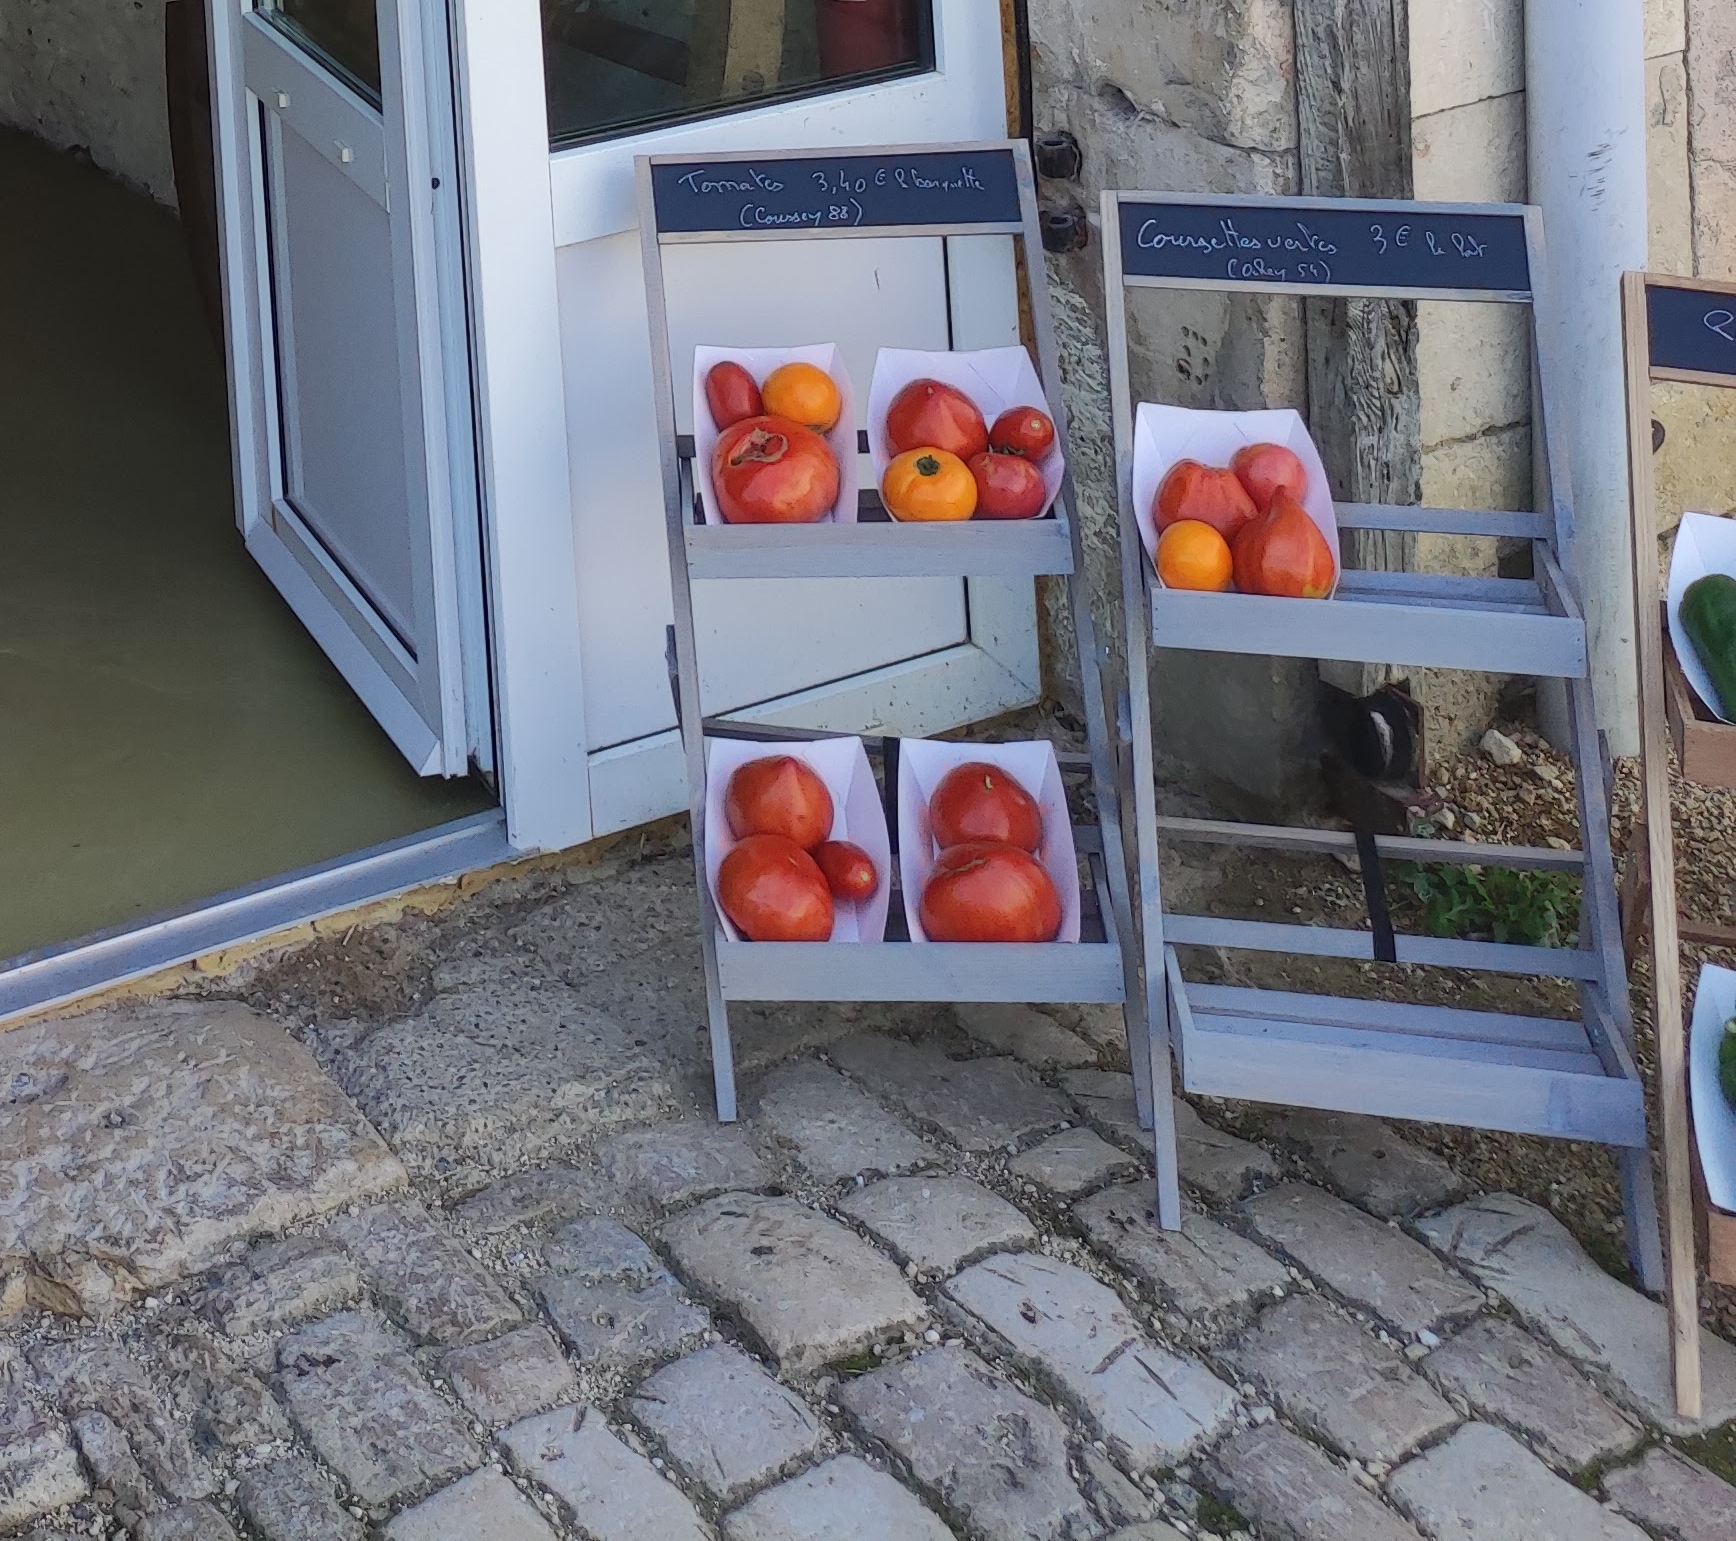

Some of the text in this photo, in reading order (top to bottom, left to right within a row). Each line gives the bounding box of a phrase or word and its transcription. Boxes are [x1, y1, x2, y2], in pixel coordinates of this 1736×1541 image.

[677, 167, 786, 194] Tomates
[810, 170, 867, 195] 3,40
[873, 168, 887, 188] €
[910, 167, 986, 194] barquette
[1136, 218, 1262, 254] Courgettes
[1265, 220, 1340, 257] vertes
[1369, 223, 1388, 256] 3
[1394, 224, 1413, 248] €
